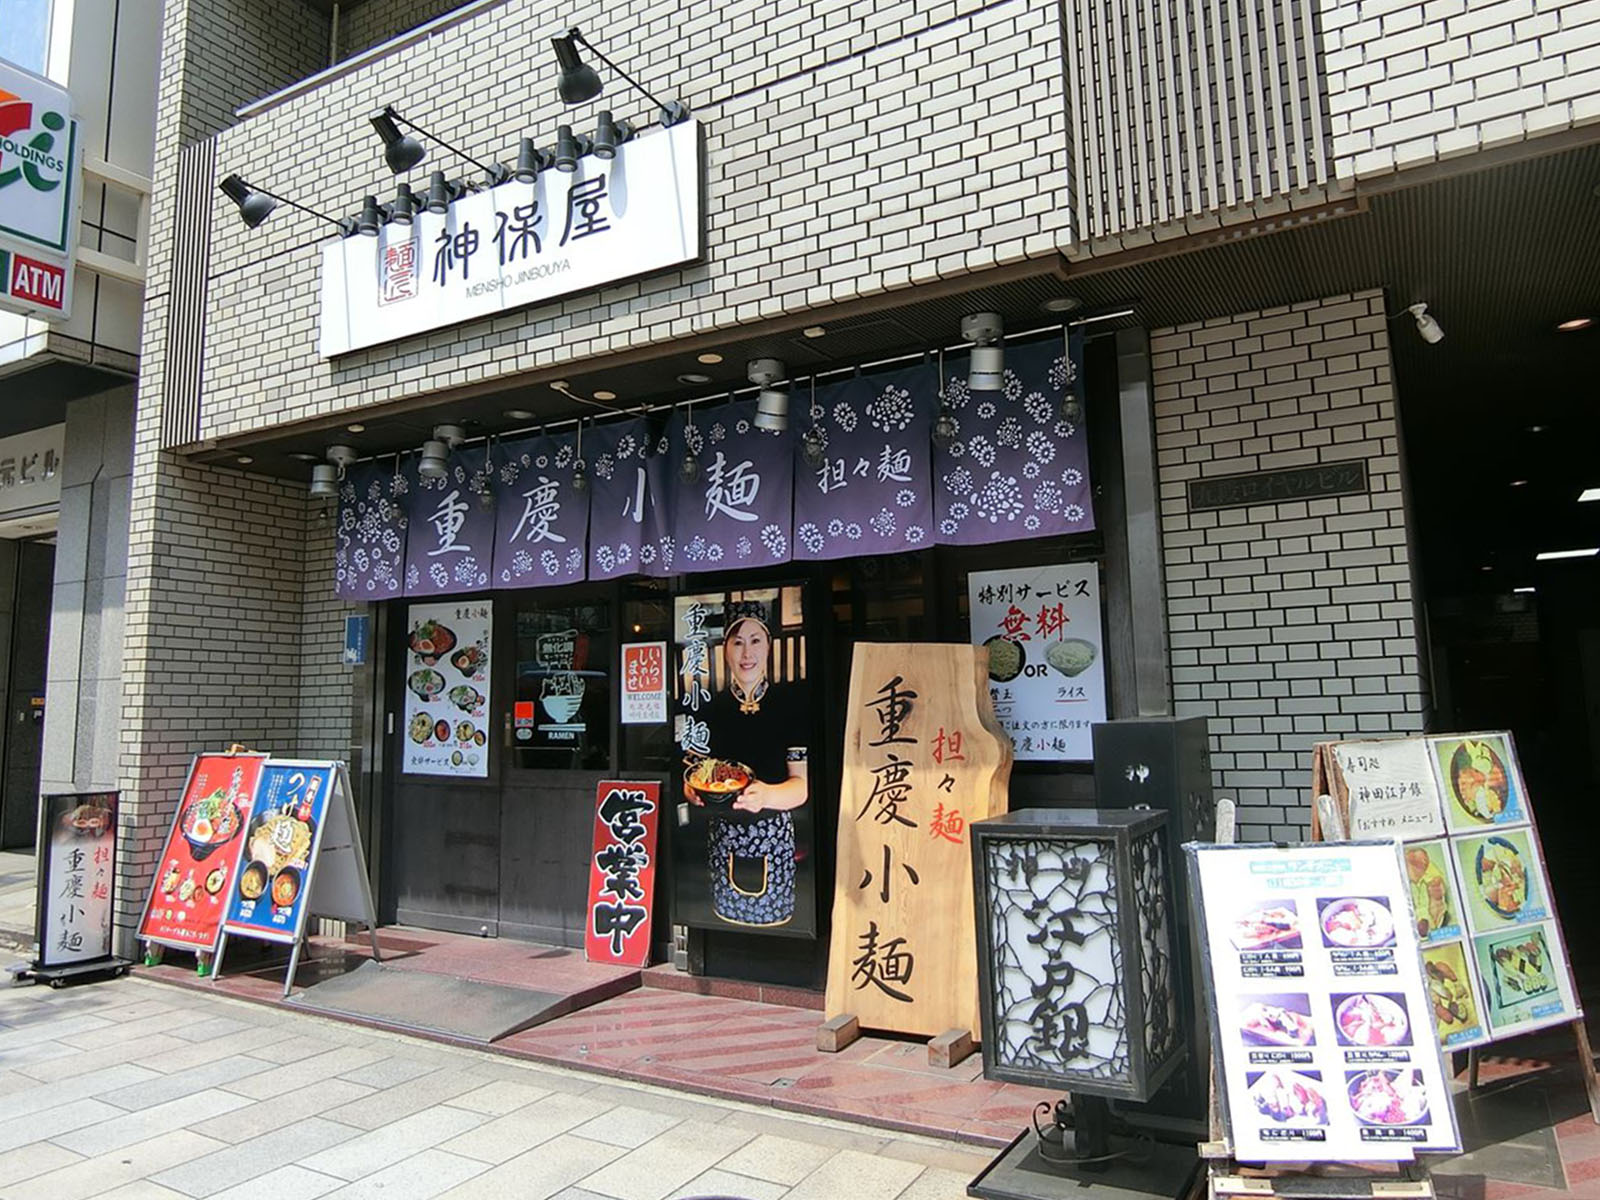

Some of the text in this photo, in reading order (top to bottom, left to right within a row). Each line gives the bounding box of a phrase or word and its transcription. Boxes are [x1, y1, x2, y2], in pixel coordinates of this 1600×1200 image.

[432, 173, 612, 287] 神保屋
[14, 263, 62, 302] ATM
[465, 258, 572, 299] MENSHO JINBOUYA
[815, 444, 914, 495] 担々麺
[977, 579, 1091, 605] 特別サービス
[998, 602, 1071, 643] 無料
[1024, 664, 1048, 678] OR
[627, 692, 662, 701] WELCOME
[1057, 686, 1086, 699] ライス
[548, 731, 575, 740] RAMEN
[928, 726, 966, 845] 担々麺
[849, 675, 920, 1004] 重慶小麺
[91, 846, 111, 901] 担々麺
[592, 789, 656, 956] 営業中
[57, 847, 86, 953] 重慶小麺
